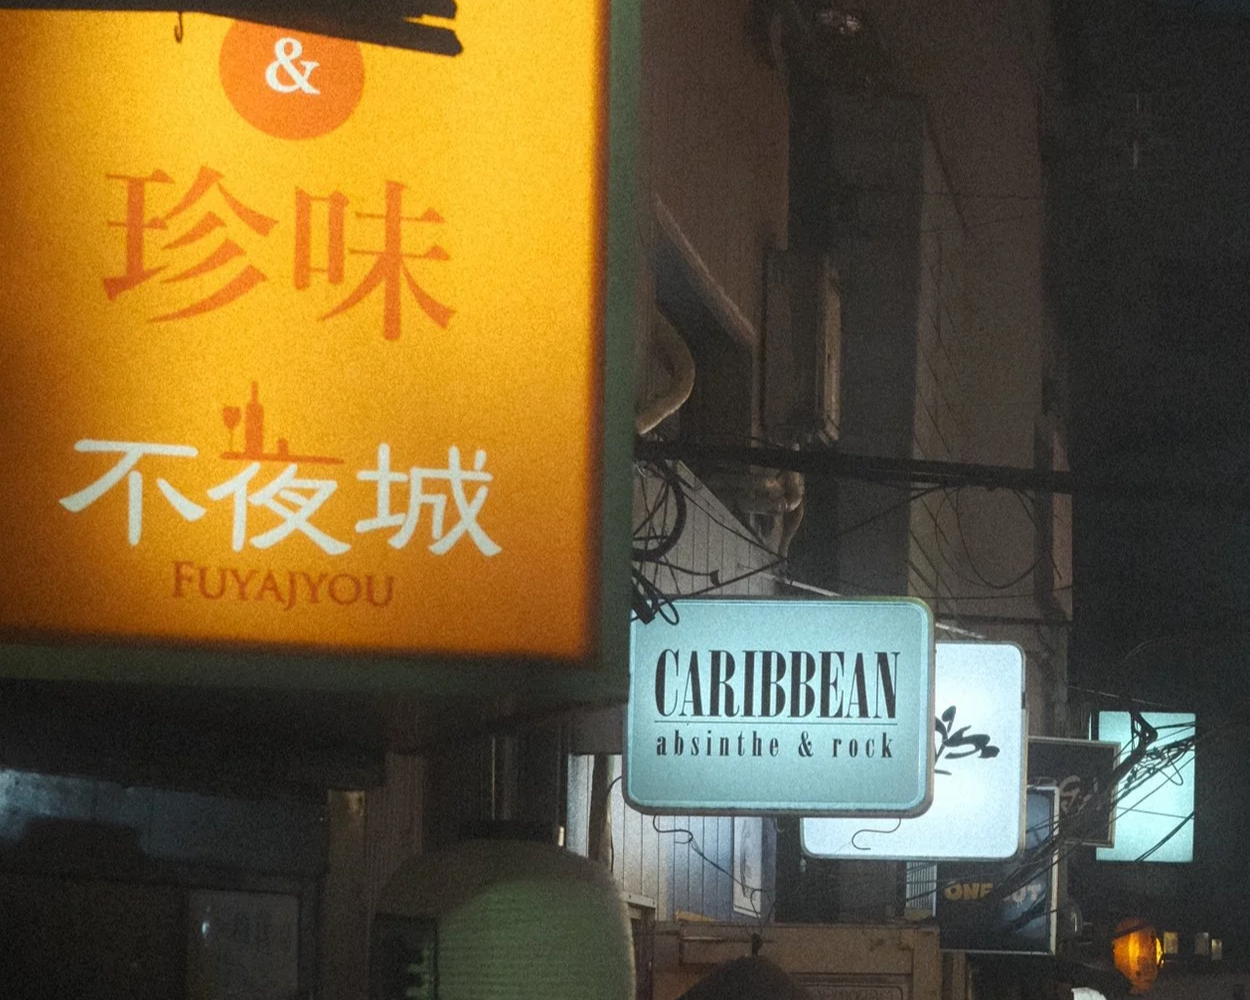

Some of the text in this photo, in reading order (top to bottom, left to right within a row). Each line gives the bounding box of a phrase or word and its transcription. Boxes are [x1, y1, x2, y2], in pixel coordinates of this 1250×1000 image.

[264, 37, 321, 95] &
[102, 164, 458, 342] 珍味
[58, 438, 503, 558] 不夜城
[171, 560, 396, 612] FUYAJYOU
[654, 648, 901, 720] CARIBBEAN
[656, 730, 894, 759] absinthe & rock
